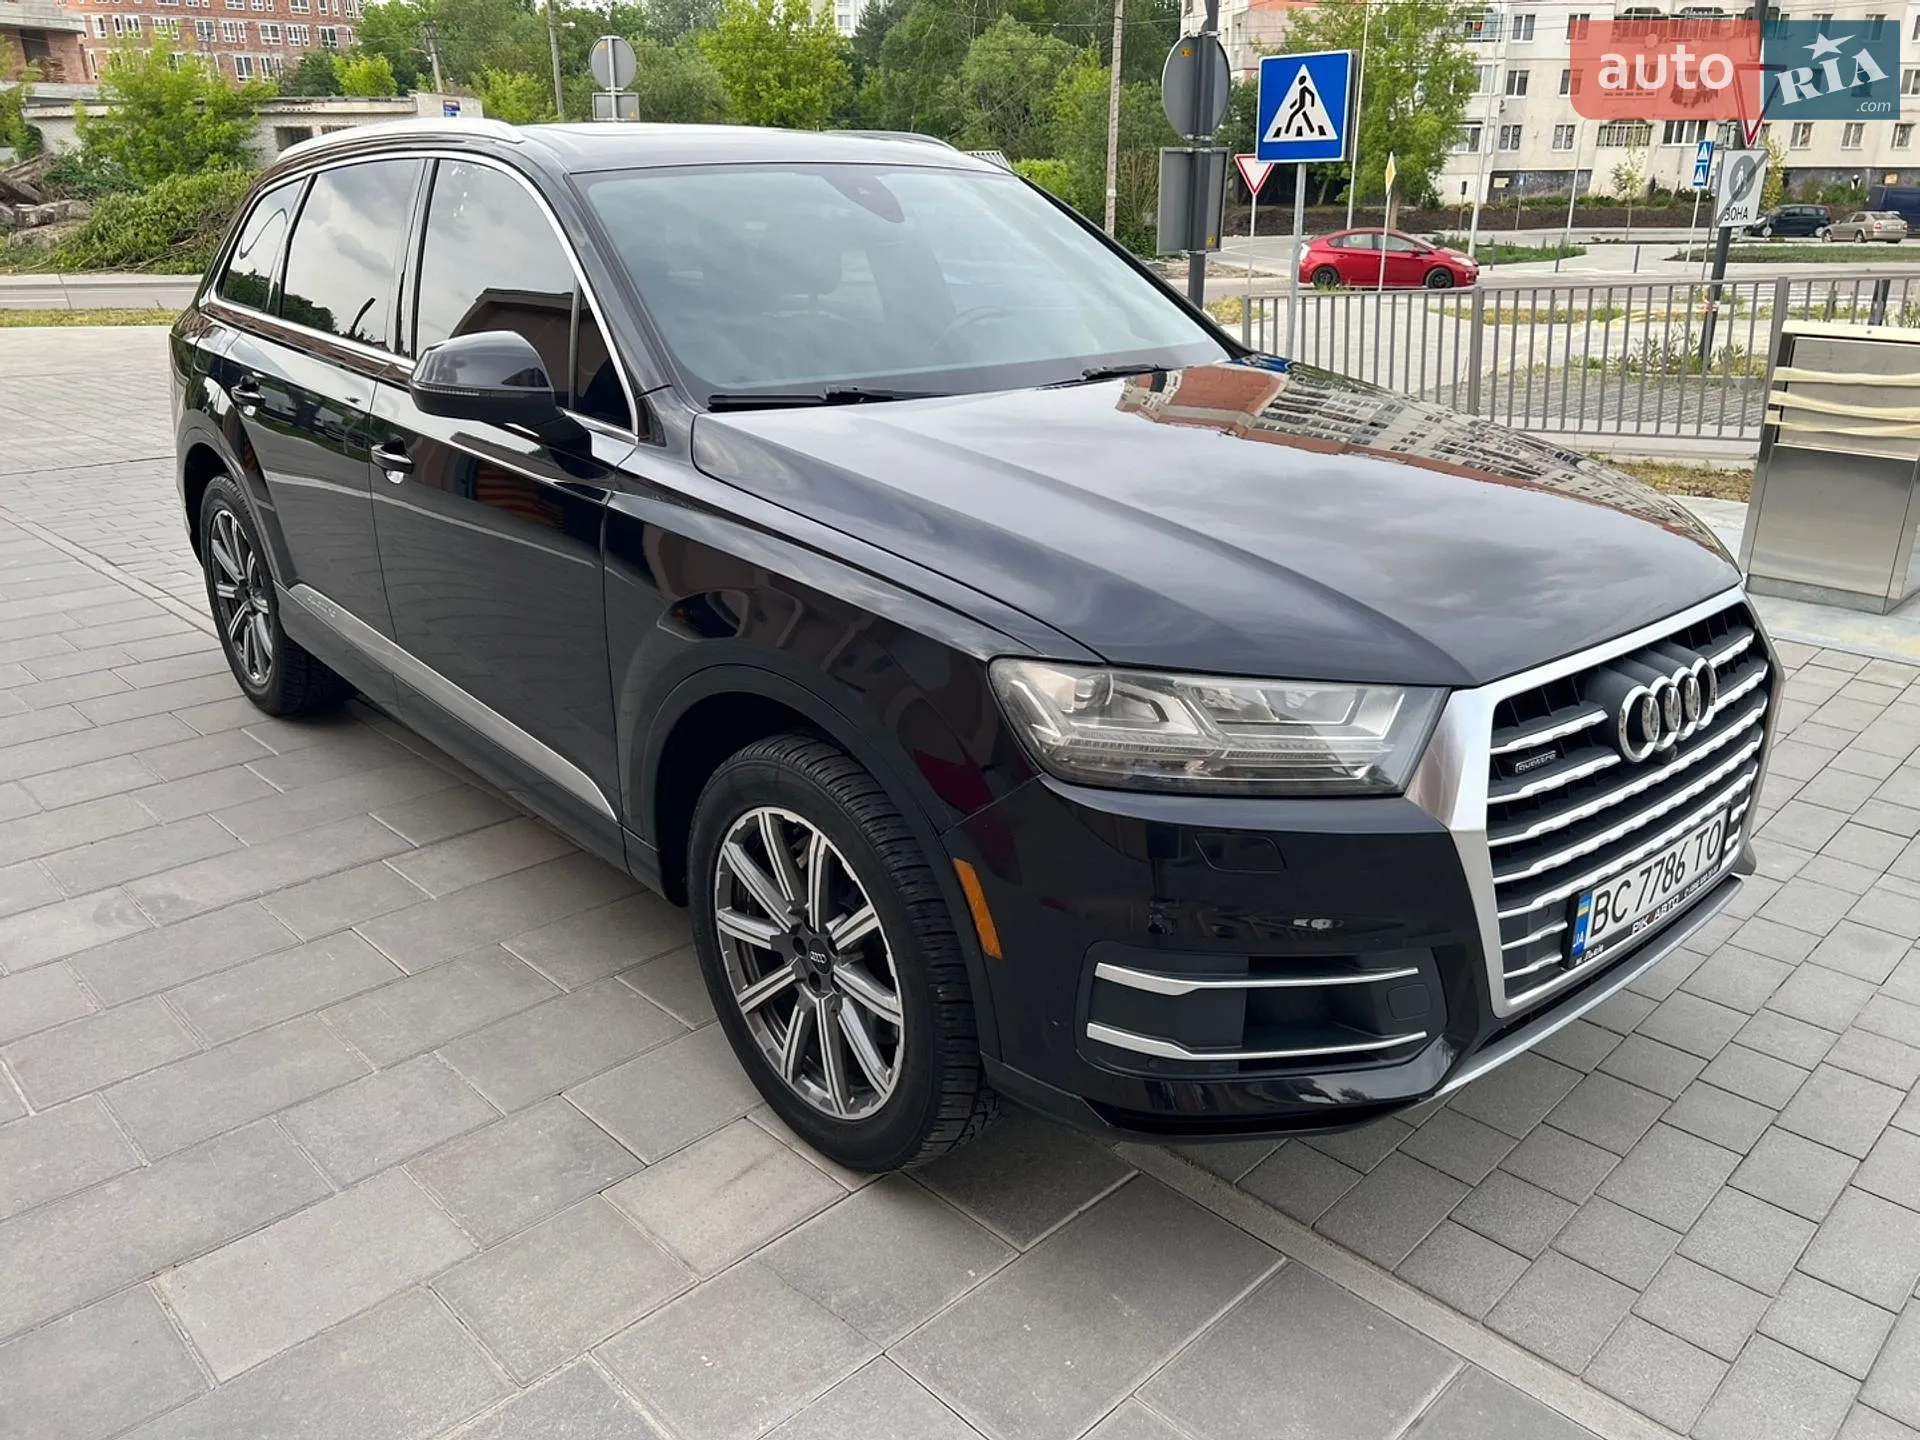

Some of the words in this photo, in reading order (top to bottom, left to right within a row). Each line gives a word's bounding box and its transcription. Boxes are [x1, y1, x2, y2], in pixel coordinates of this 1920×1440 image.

[1724, 206, 1748, 221] ЗОНА
[1591, 879, 1631, 937] BC
[1635, 841, 1689, 913] 7786
[1694, 819, 1722, 873] TO
